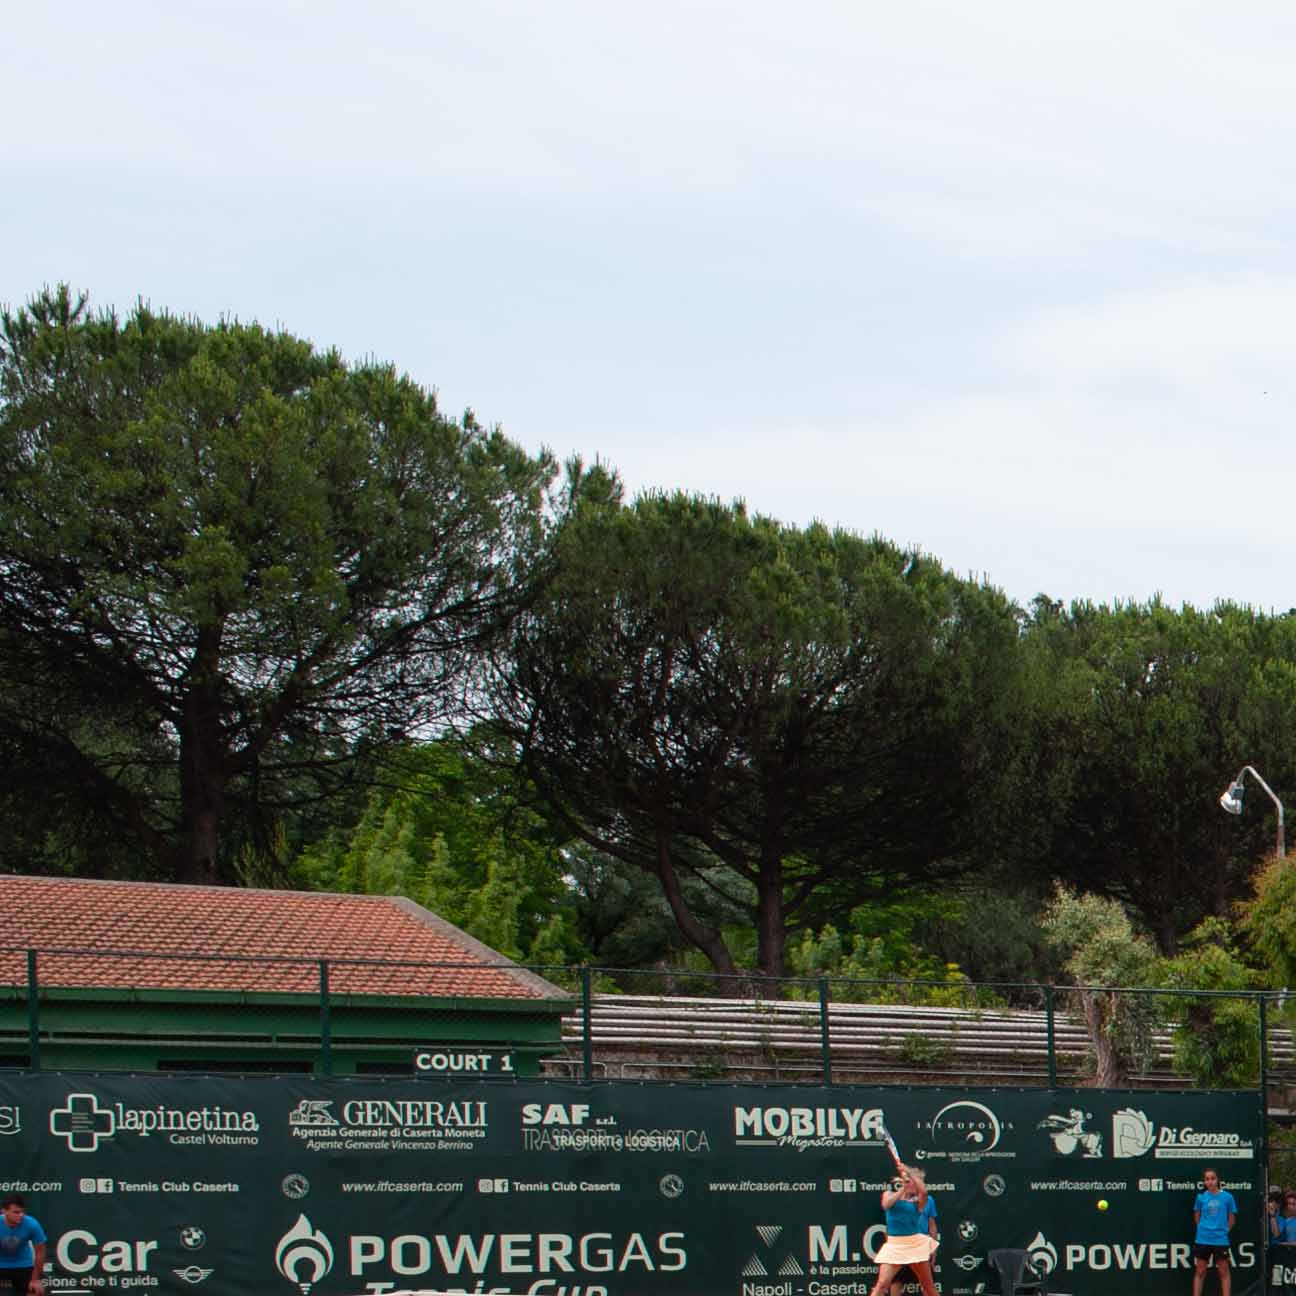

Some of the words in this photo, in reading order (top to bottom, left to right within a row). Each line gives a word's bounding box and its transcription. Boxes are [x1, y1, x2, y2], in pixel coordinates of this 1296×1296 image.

[416, 1053, 492, 1071] COURT
[501, 1054, 514, 1071] 1
[115, 1102, 260, 1136] lapinetina
[343, 1100, 489, 1127] GENERALI
[521, 1103, 590, 1125] SAF
[734, 1106, 885, 1140] MOBILYA
[169, 1133, 206, 1145] Castel
[207, 1133, 259, 1145] Volturno
[292, 1127, 337, 1140] Agenzia
[339, 1127, 388, 1138] Generale
[390, 1127, 401, 1138] di
[403, 1128, 443, 1139] Caserta
[444, 1128, 486, 1139] Moneta
[1159, 1126, 1177, 1144] Di
[1179, 1126, 1240, 1146] Gennaro
[306, 1139, 343, 1151] Agente
[345, 1139, 390, 1150] Generale
[118, 1181, 159, 1193] Tennis
[161, 1181, 190, 1193] Club
[192, 1181, 239, 1193] Caserta
[342, 1179, 464, 1193] www.itfcaserta.com
[513, 1181, 549, 1193] Tennis
[551, 1181, 577, 1193] Club
[579, 1181, 621, 1193] Caserta
[708, 1179, 817, 1193] www.itfcaserta.com
[859, 1181, 892, 1192] Tennis
[925, 1181, 956, 1192] aserta
[1030, 1178, 1127, 1192] www.itfcaserta.com
[1165, 1180, 1196, 1191] Tennis
[42, 1229, 158, 1272] .Car
[350, 1231, 687, 1276] POWERGAS
[818, 1265, 830, 1275] la
[40, 1276, 77, 1288] sione
[80, 1275, 105, 1287] che
[108, 1275, 118, 1287] ti
[120, 1275, 159, 1289] guida
[807, 1281, 868, 1296] Caserta
